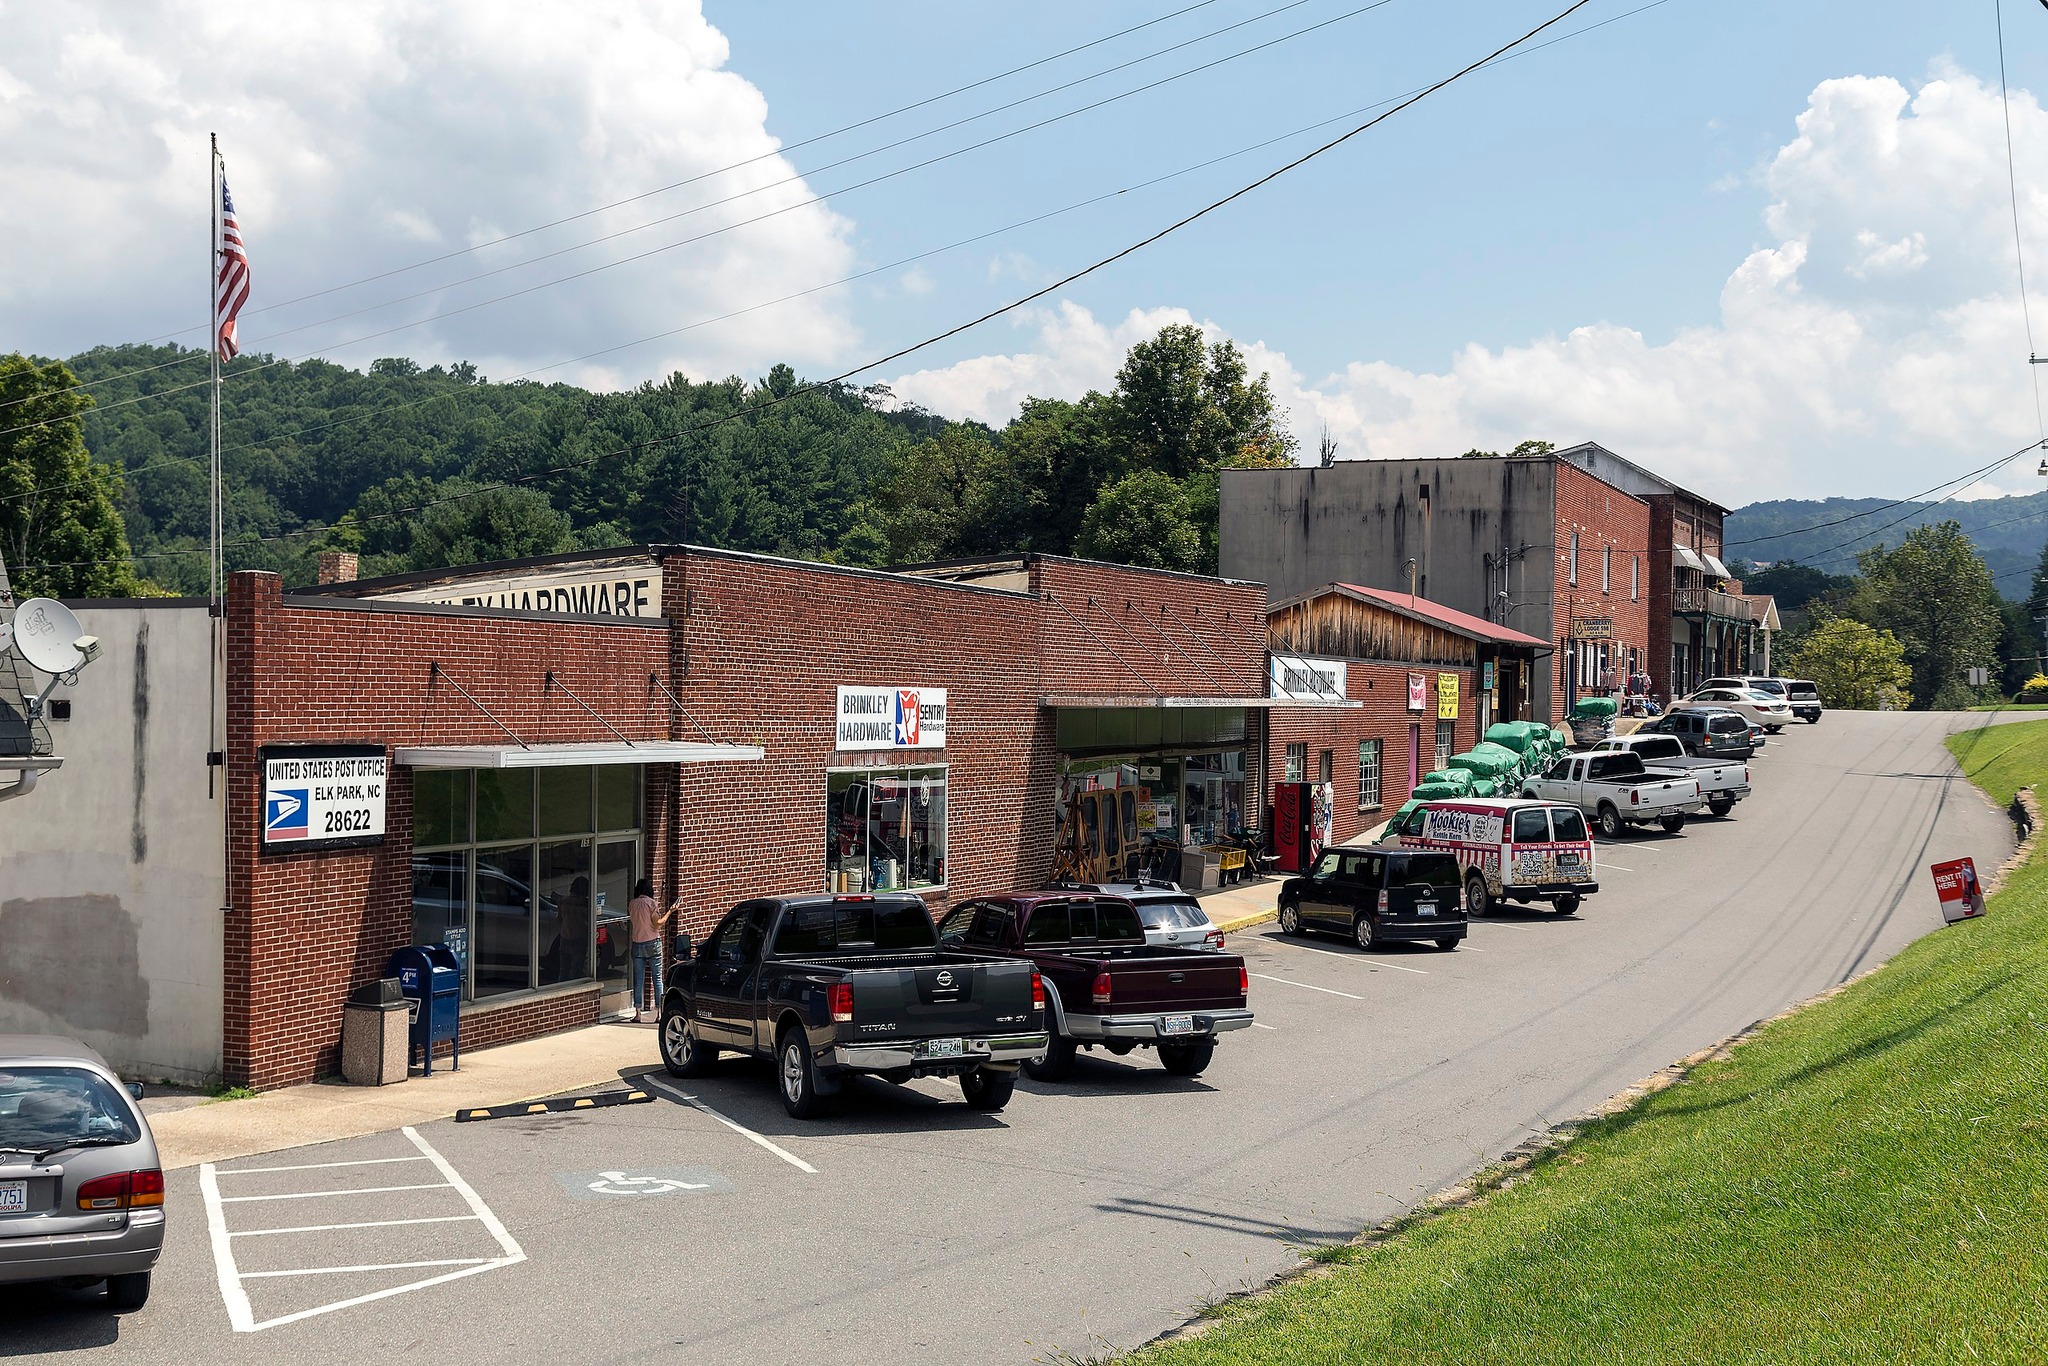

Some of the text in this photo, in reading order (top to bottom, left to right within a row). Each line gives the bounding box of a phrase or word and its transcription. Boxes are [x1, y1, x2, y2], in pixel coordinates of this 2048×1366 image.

[1284, 668, 1335, 694] BRINKLEY HARDWARE
[843, 695, 889, 714] BRINKLEY
[920, 704, 945, 720] SENTRY
[839, 722, 892, 741] HARDWARE
[920, 721, 944, 731] Hardware
[269, 759, 385, 780] UNITED STATES POST OFFICE
[315, 785, 380, 801] ELK PARK, NC
[325, 809, 371, 832] 28622
[1428, 811, 1471, 833] Mookie's
[1432, 831, 1448, 839] Kettle
[1936, 872, 1962, 883] RENT IT
[1937, 881, 1957, 890] HERE
[860, 1023, 896, 1032] TITAN
[0, 1189, 24, 1205] 751
